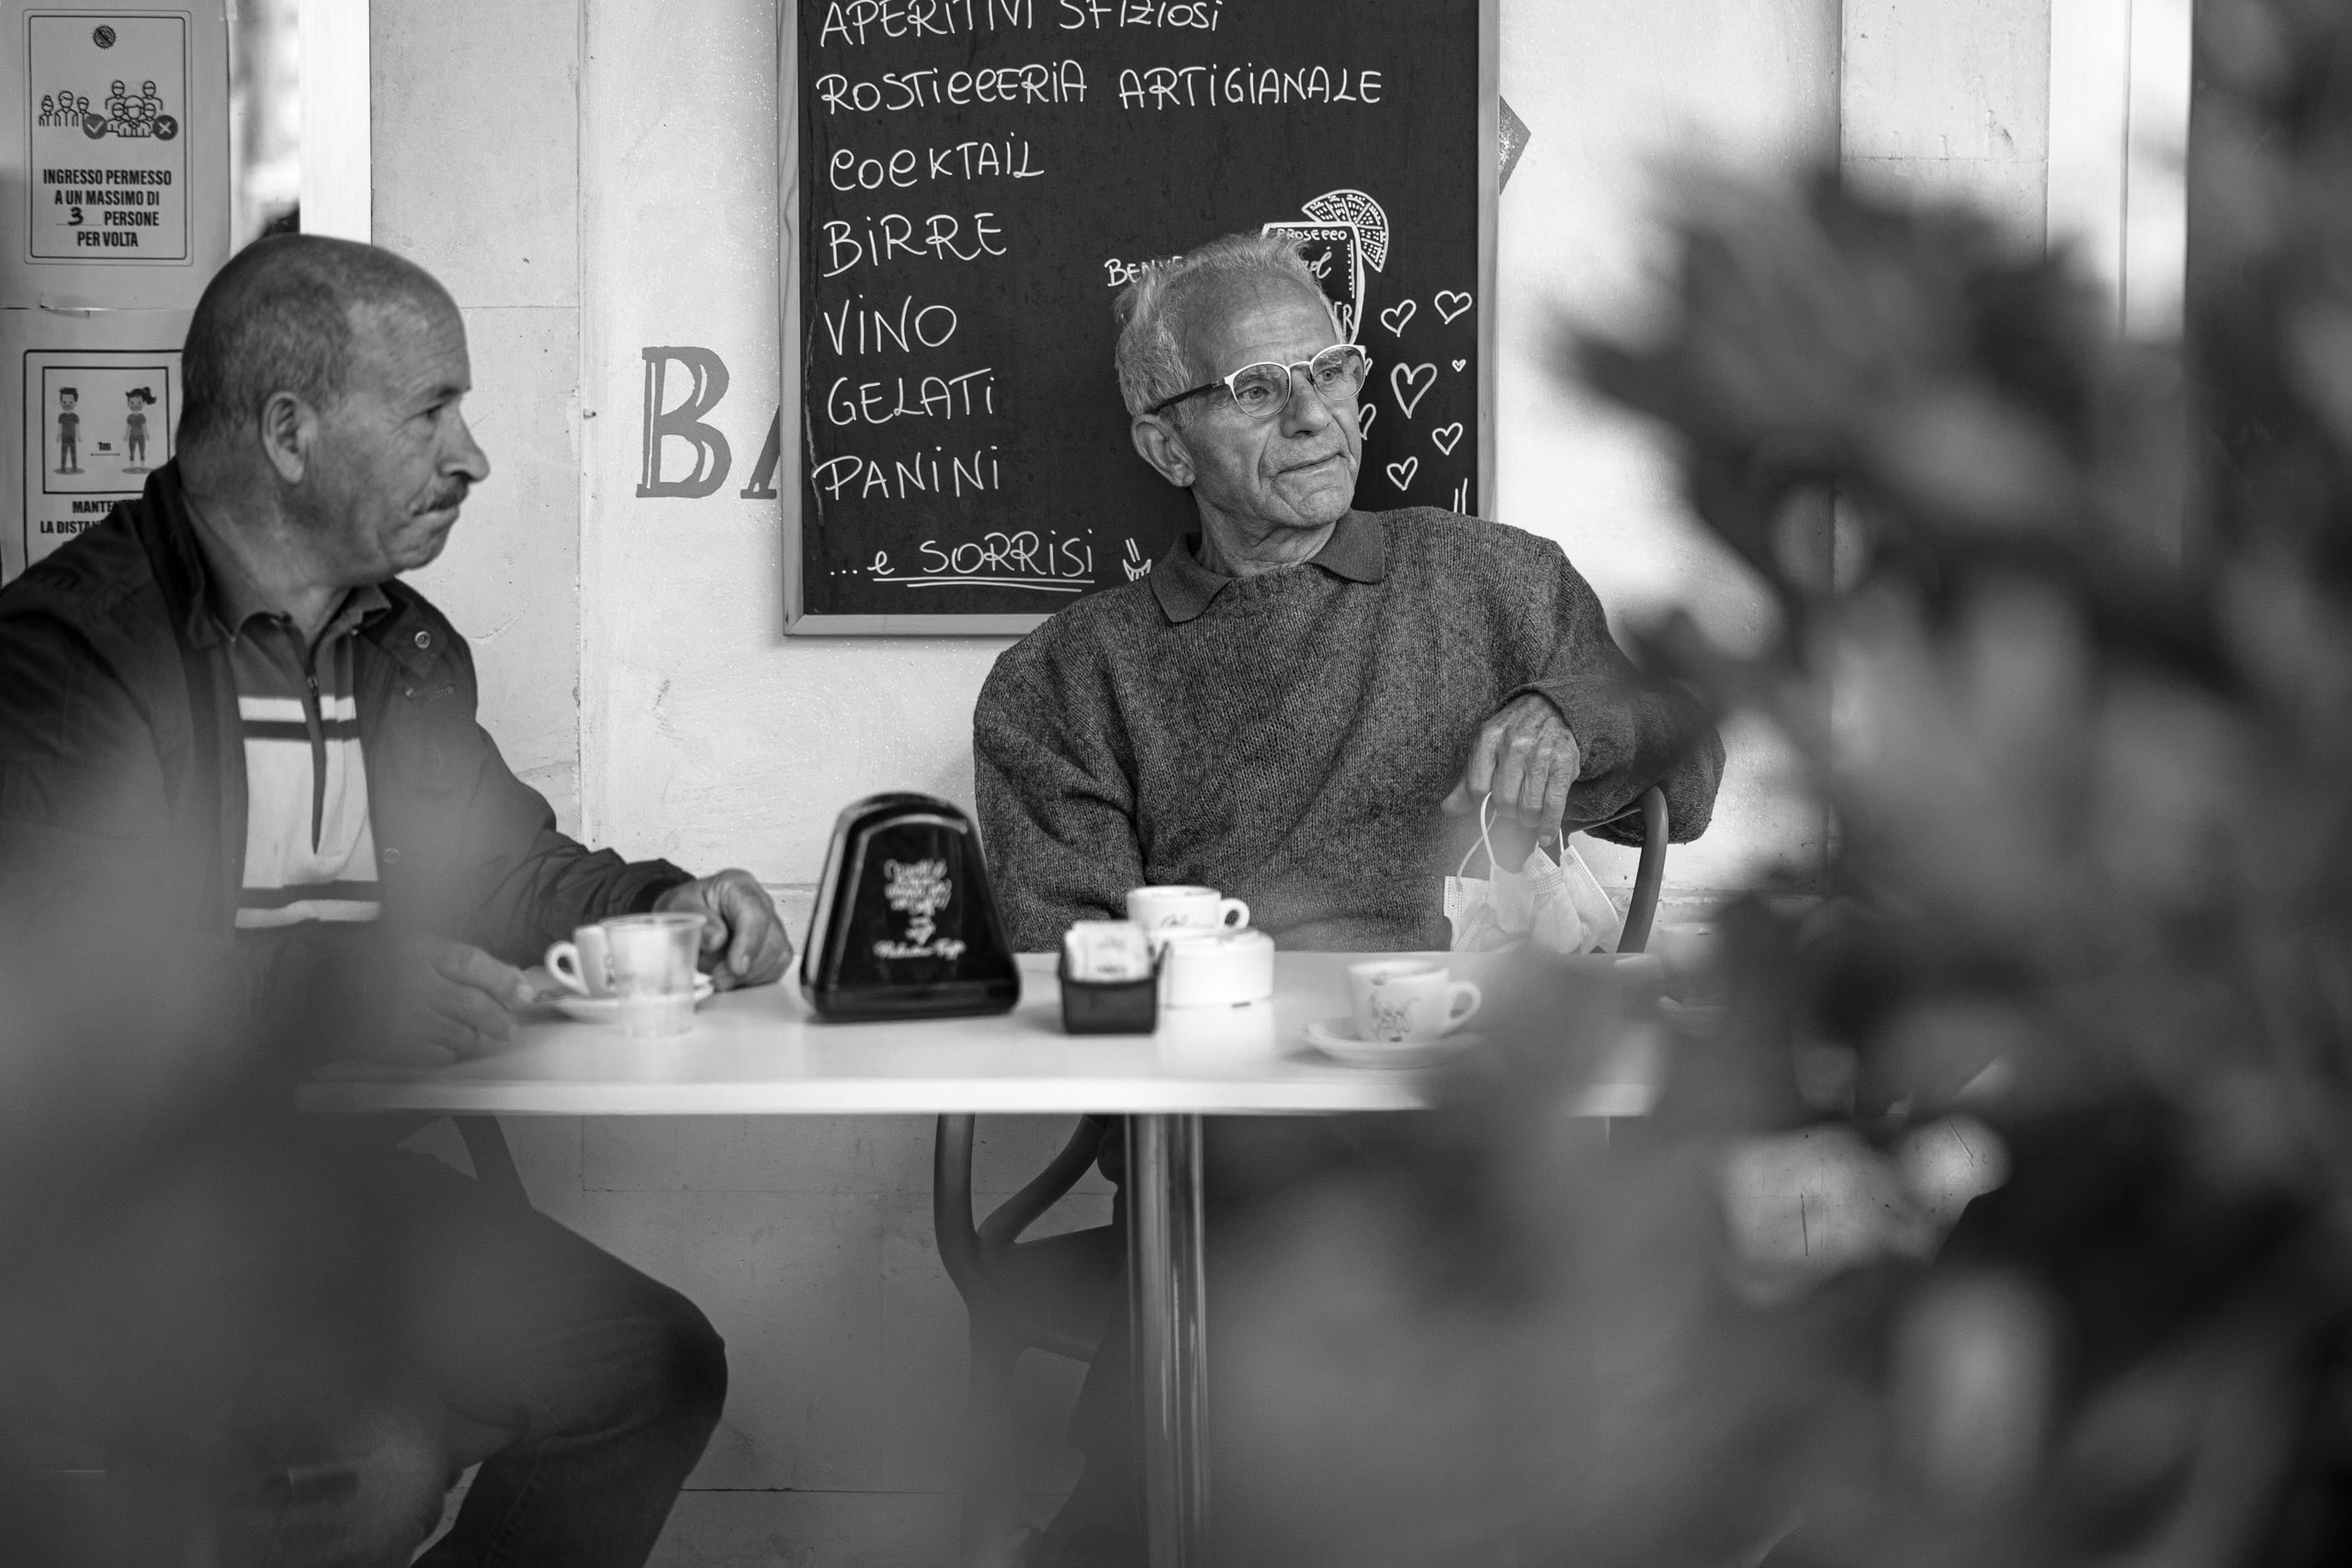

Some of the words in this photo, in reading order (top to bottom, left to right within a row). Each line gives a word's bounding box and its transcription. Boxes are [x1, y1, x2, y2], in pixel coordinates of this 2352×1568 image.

[1119, 62, 1382, 110] ARTIGIANALE
[43, 169, 103, 186] INGRESSO
[106, 169, 172, 186] PERMESSO
[54, 190, 62, 205] A
[65, 190, 83, 206] UN
[85, 190, 144, 206] MASSIMO
[146, 190, 160, 206] DI
[68, 207, 84, 226] 3
[104, 211, 160, 227] PERSONE
[77, 231, 100, 247] PER
[102, 231, 139, 247] VOLTA
[40, 521, 53, 534] LA
